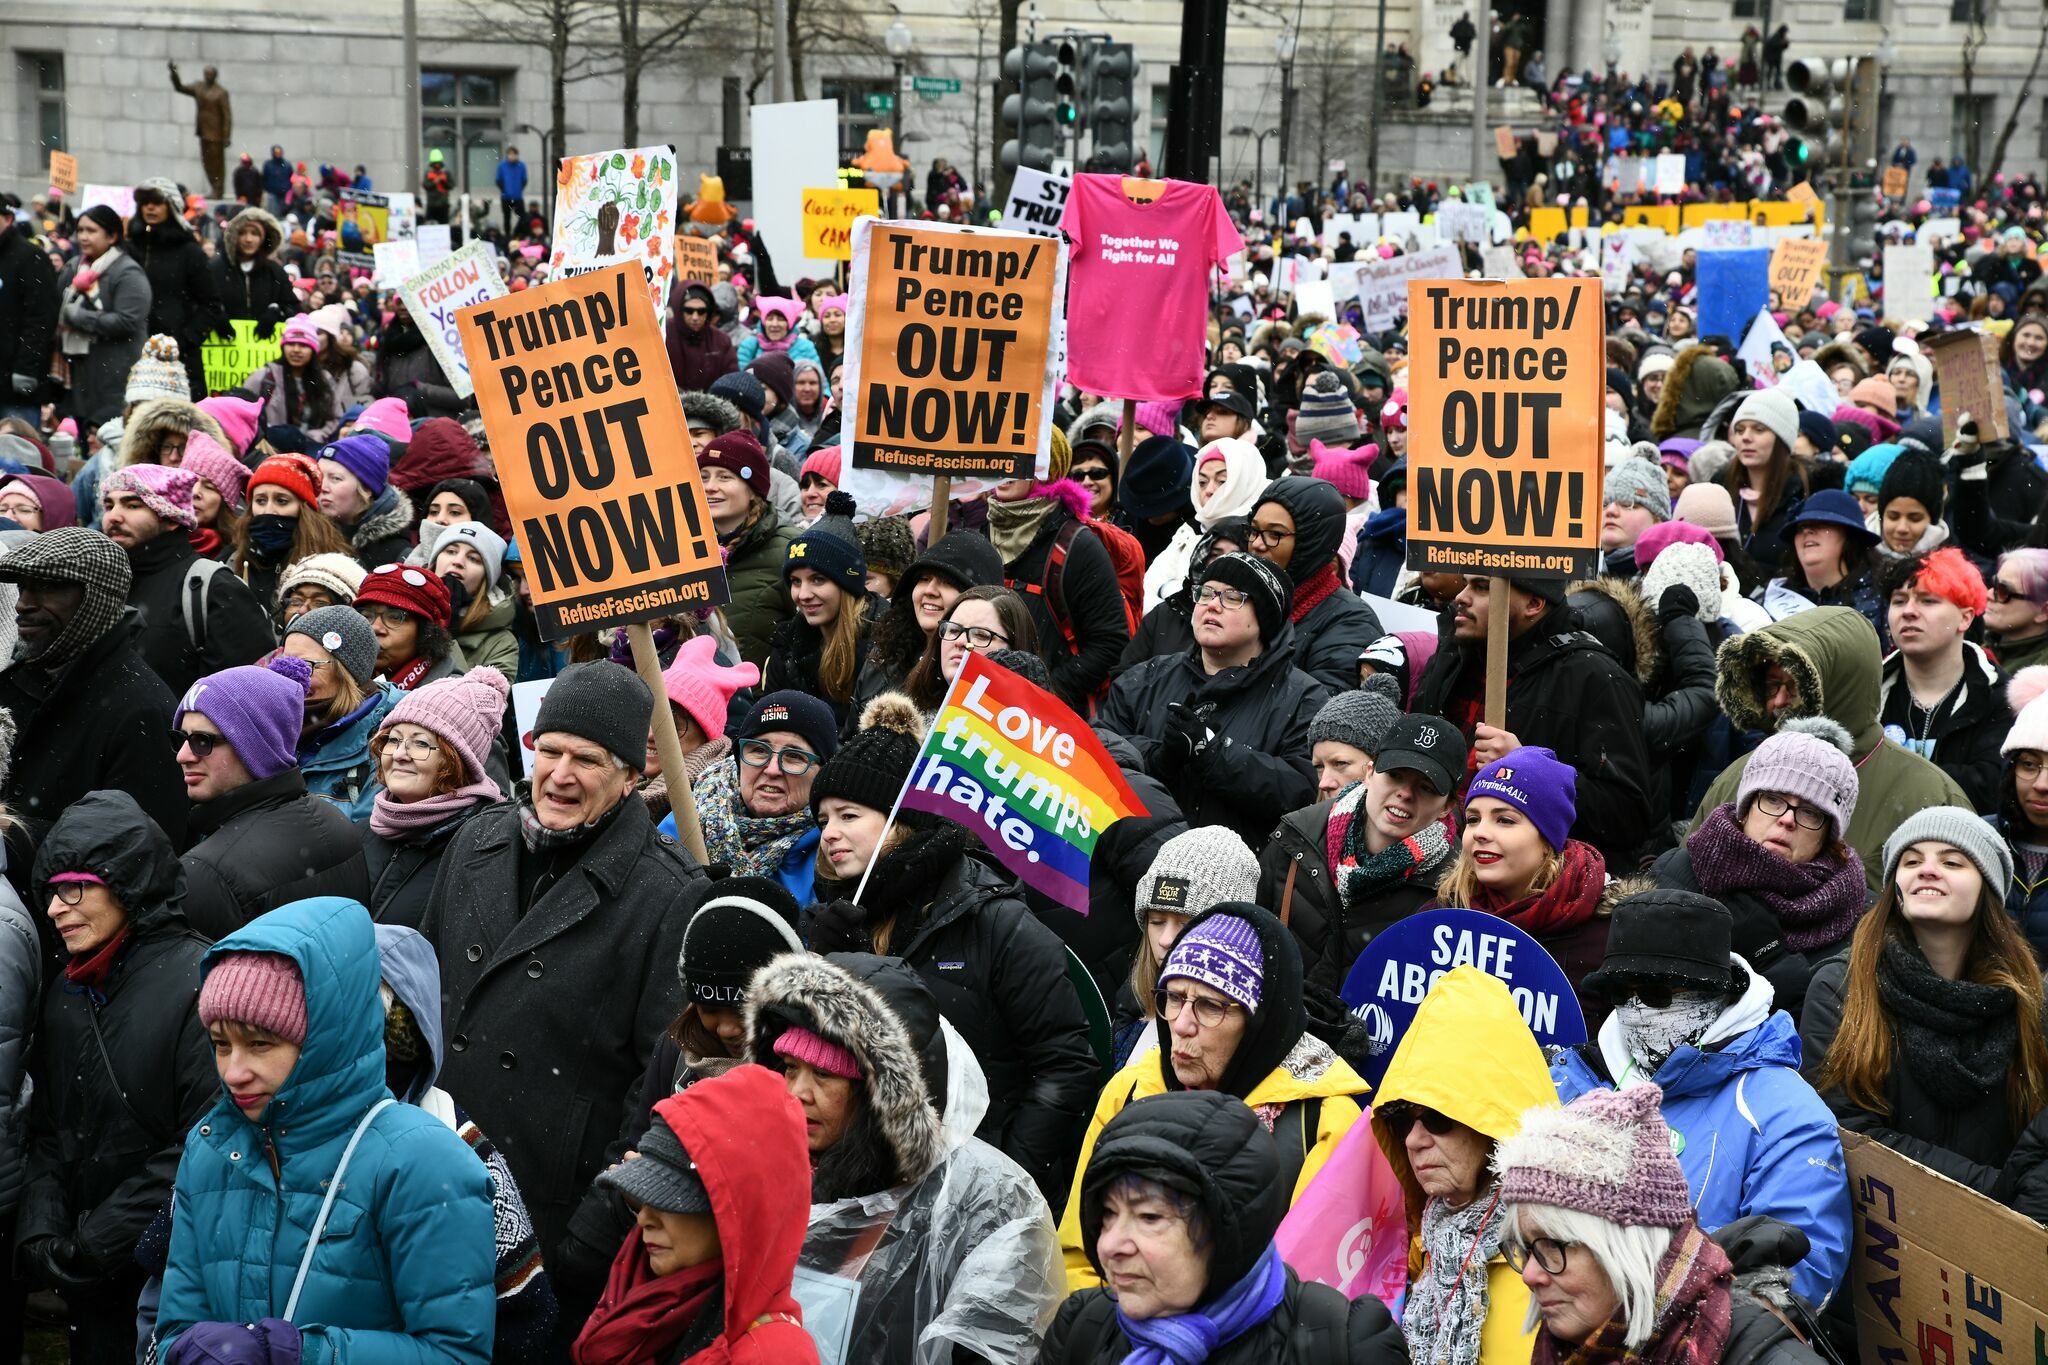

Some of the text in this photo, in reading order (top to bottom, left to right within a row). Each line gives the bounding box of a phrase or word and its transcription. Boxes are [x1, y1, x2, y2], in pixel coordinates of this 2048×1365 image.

[804, 199, 864, 216] Close the
[1012, 198, 1061, 227] TRU
[820, 228, 851, 247] CAM
[889, 234, 1041, 286] Trump/
[1100, 234, 1179, 251] Together We
[1102, 251, 1175, 266] Fight for All
[418, 260, 480, 308] FOLLOW
[683, 255, 712, 269] Pence
[687, 270, 713, 286] OUT
[1778, 267, 1810, 282] OUT
[430, 288, 490, 331] YONG
[473, 272, 630, 361] Trump/
[895, 277, 1023, 321] Pence
[1427, 286, 1582, 340] Trump/
[896, 322, 1017, 382] OUT
[1438, 337, 1568, 381] Pence
[499, 346, 642, 416] Pence
[866, 383, 1030, 446] NOW!
[1442, 390, 1562, 459] OUT
[526, 397, 653, 500] OUT
[874, 448, 1014, 474] RefuseFascism.org
[1417, 467, 1584, 538] NOW!
[523, 482, 709, 592] NOW!
[789, 543, 807, 559] M
[1428, 546, 1574, 573] RefuseFascism.org
[559, 580, 710, 626] RefuseFascism.org
[761, 712, 789, 722] RISING
[961, 674, 1076, 768] Love
[1414, 726, 1439, 748] B
[940, 715, 1093, 839] trumps
[915, 753, 1040, 863] hate.
[1431, 924, 1517, 979] SAFE
[1223, 981, 1252, 1004] RUN
[1377, 959, 1559, 1035] ABON
